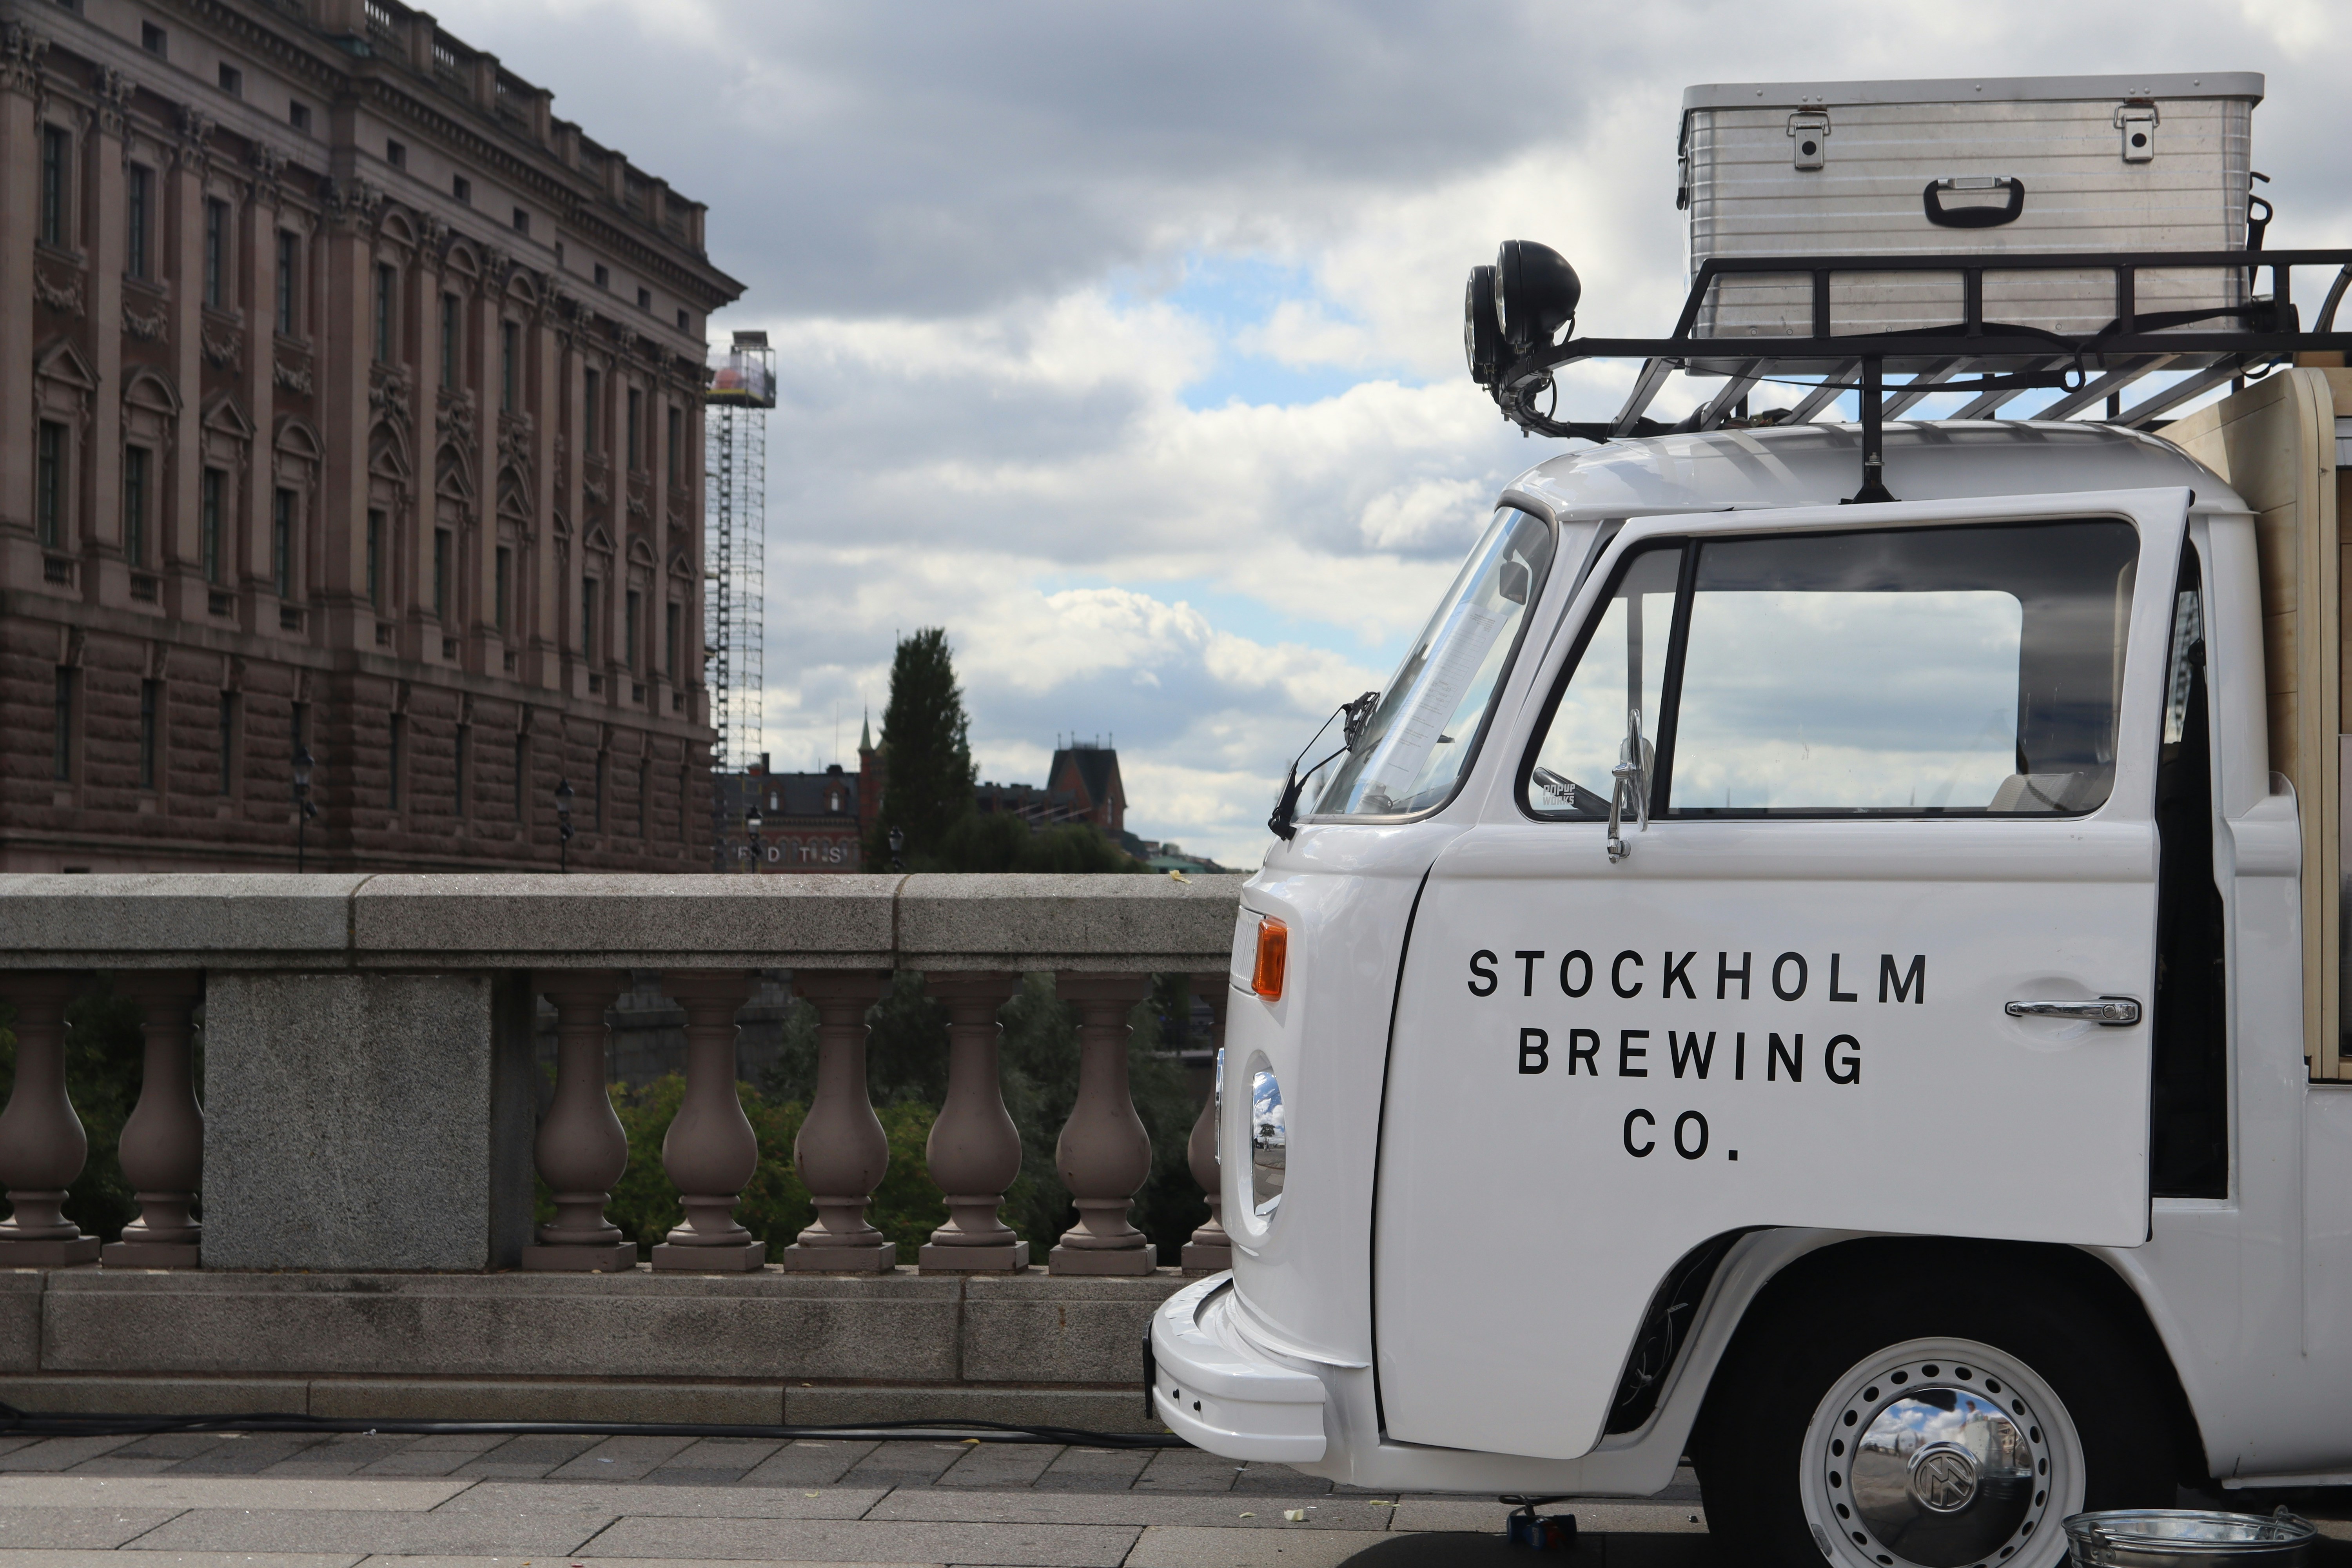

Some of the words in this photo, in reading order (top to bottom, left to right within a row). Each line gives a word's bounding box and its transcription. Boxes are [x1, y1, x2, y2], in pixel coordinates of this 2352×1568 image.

[1543, 795, 1575, 806] WORKS
[1467, 949, 1926, 1005] STOCKHOLM
[1518, 1027, 1861, 1085] BREWING
[1623, 1108, 1739, 1161] CO.
